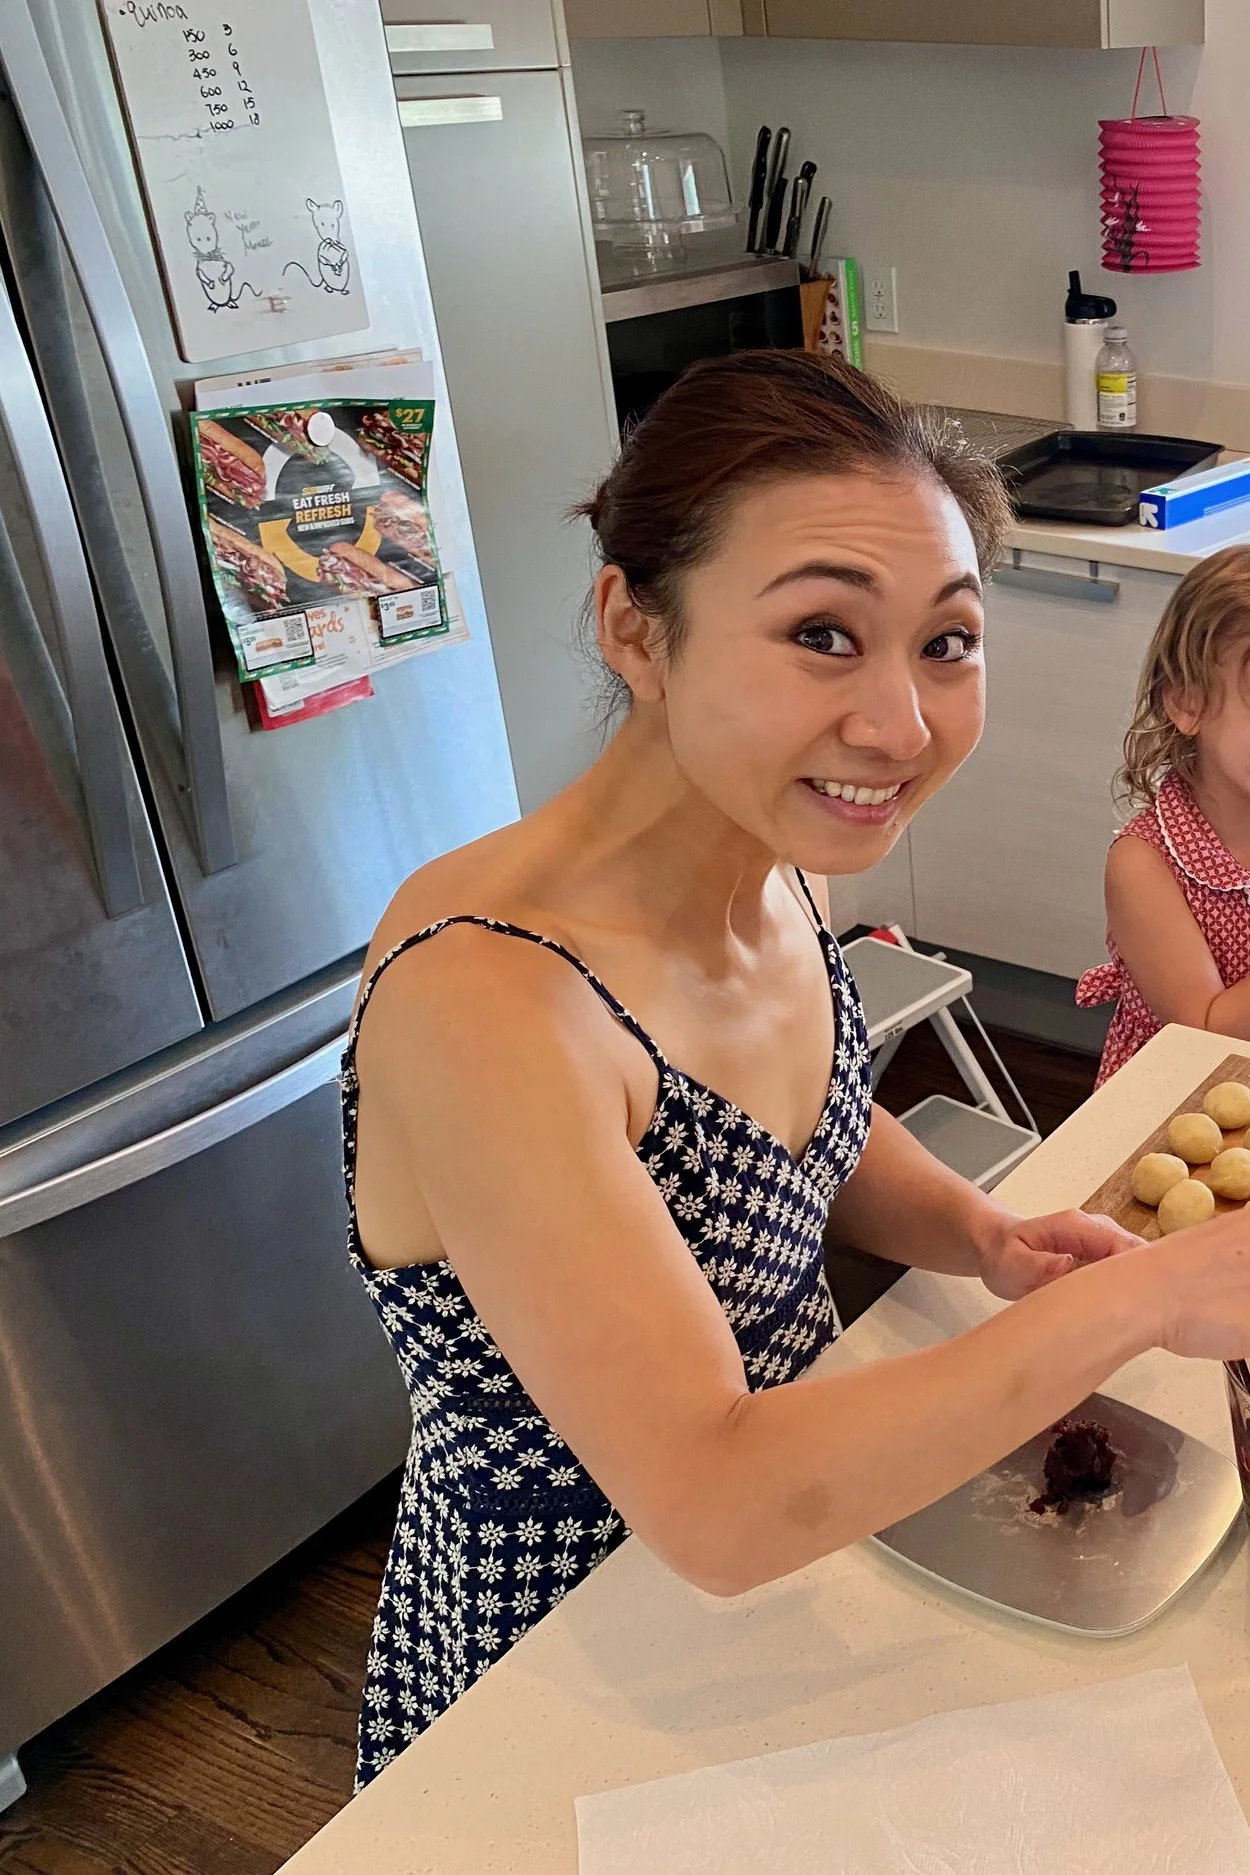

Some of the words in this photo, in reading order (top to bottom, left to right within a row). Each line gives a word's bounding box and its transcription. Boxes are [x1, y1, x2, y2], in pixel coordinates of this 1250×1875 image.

[182, 28, 206, 43] 150
[188, 48, 210, 62] 300
[228, 42, 238, 56] 6
[193, 67, 217, 79] 450
[232, 61, 242, 77] 9
[200, 85, 222, 98] 600
[237, 79, 253, 93] 12
[204, 103, 228, 116] 750
[243, 96, 256, 110] 15
[209, 119, 235, 133] 1000
[249, 112, 260, 126] 18
[395, 407, 426, 424] $27
[292, 496, 313, 510] EAT
[314, 491, 351, 507] FRESH
[295, 503, 353, 524] REFRESH
